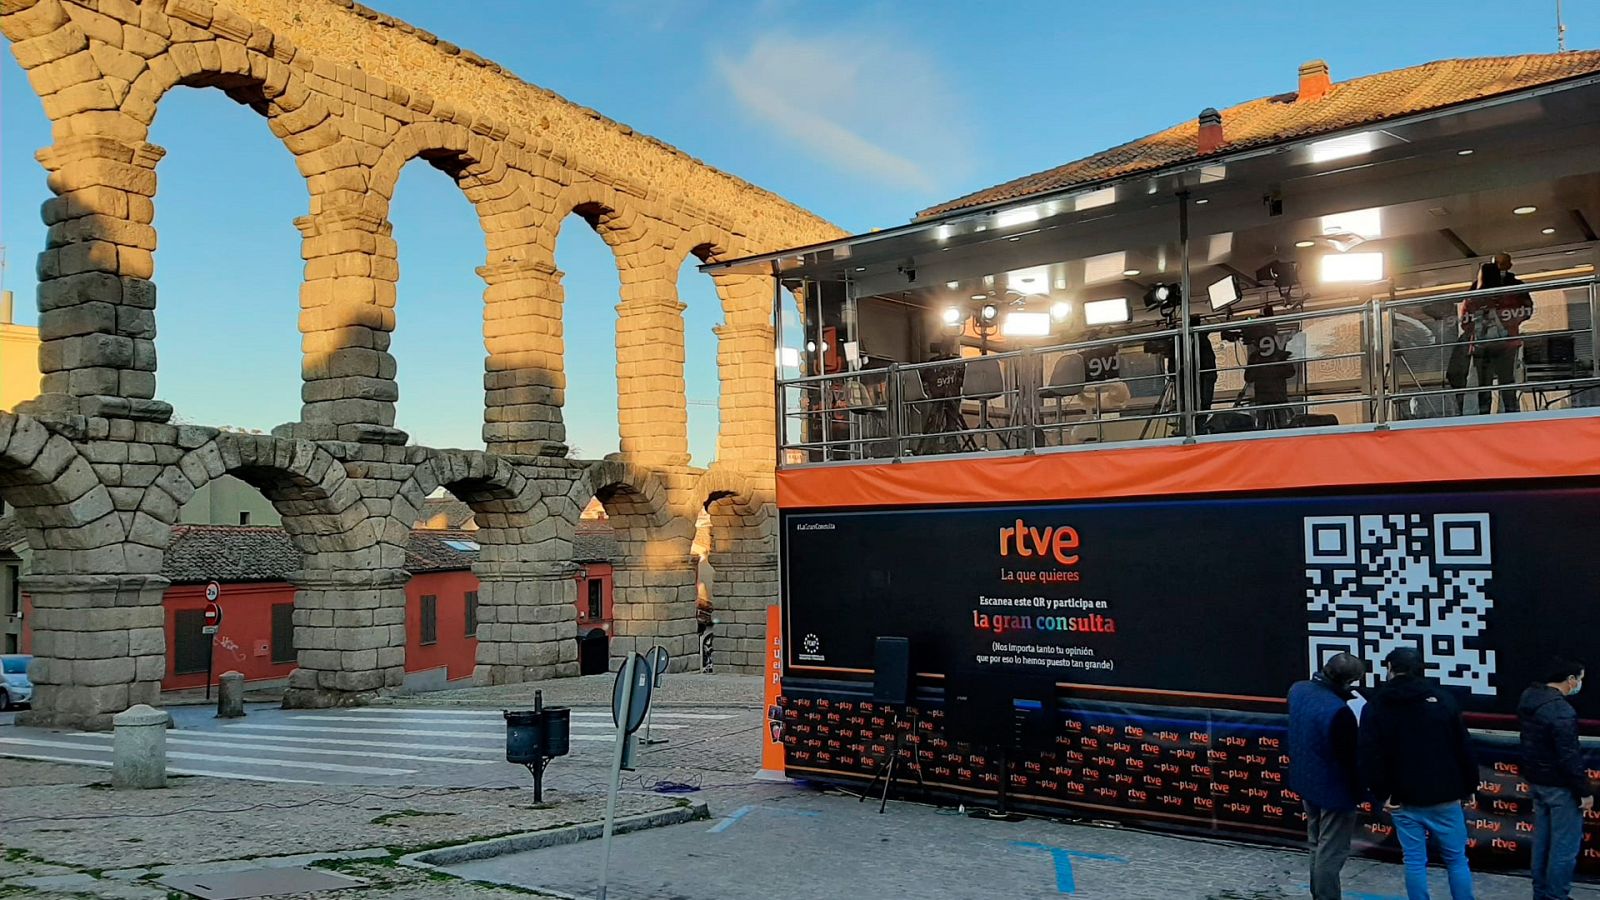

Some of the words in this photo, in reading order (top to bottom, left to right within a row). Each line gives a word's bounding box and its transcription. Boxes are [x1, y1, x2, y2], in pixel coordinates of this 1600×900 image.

[1000, 518, 1080, 564] rtve
[1001, 568, 1013, 581] La
[1016, 572, 1036, 584] que
[1038, 568, 1080, 584] quieres
[980, 596, 1012, 606] Escanea
[1014, 598, 1032, 606] este
[1033, 597, 1046, 607] QR
[1046, 600, 1052, 609] y
[1053, 598, 1094, 610] participa
[1096, 600, 1108, 608] en
[972, 610, 989, 628] la
[993, 614, 1032, 632] gran
[1036, 613, 1116, 632] consulta
[992, 641, 1008, 652] (Nos
[1008, 643, 1035, 654] importa
[1036, 644, 1055, 654] tanto
[1056, 646, 1064, 654] tu
[1066, 646, 1094, 656] opinión
[976, 654, 988, 663] que
[990, 656, 1000, 664] por
[1014, 655, 1022, 664] lo
[1022, 656, 1046, 666] hemos
[1046, 658, 1070, 668] puesto
[1072, 660, 1084, 668] tan
[1084, 660, 1114, 671] grande)
[860, 702, 872, 710] rtve
[784, 709, 798, 718] rtve
[828, 712, 840, 720] rtve
[872, 717, 884, 726] rtve
[918, 720, 933, 730] rtve
[906, 734, 920, 744] rtve
[1066, 720, 1082, 730] rtve
[1124, 725, 1143, 736] rtve
[1190, 731, 1208, 743] rtve
[1258, 736, 1279, 748] rtve
[828, 740, 840, 748] rtve
[872, 744, 884, 753] rtve
[970, 755, 984, 765] rtve
[1081, 736, 1098, 748] rtve
[1141, 743, 1160, 754] rtve
[1207, 749, 1227, 760] rtve
[816, 752, 830, 760] rtve
[860, 756, 874, 766] rtve
[958, 768, 972, 778] rtve
[1066, 750, 1083, 761] rtve
[1126, 757, 1143, 768] rtve
[1190, 764, 1210, 776] rtve
[1260, 770, 1280, 782] rtve
[1494, 761, 1519, 774] rtve
[1024, 761, 1040, 772] rtve
[1082, 768, 1099, 778] rtve
[1143, 774, 1162, 786] rtve
[1210, 780, 1230, 793] rtve
[1010, 774, 1027, 784] rtve
[1067, 780, 1084, 792] rtve
[1128, 788, 1147, 800] rtve
[1194, 796, 1213, 808] rtve
[1263, 803, 1283, 816] rtve
[1493, 800, 1518, 813] rtve
[1476, 818, 1501, 832] play
[1492, 838, 1517, 851] rtve
